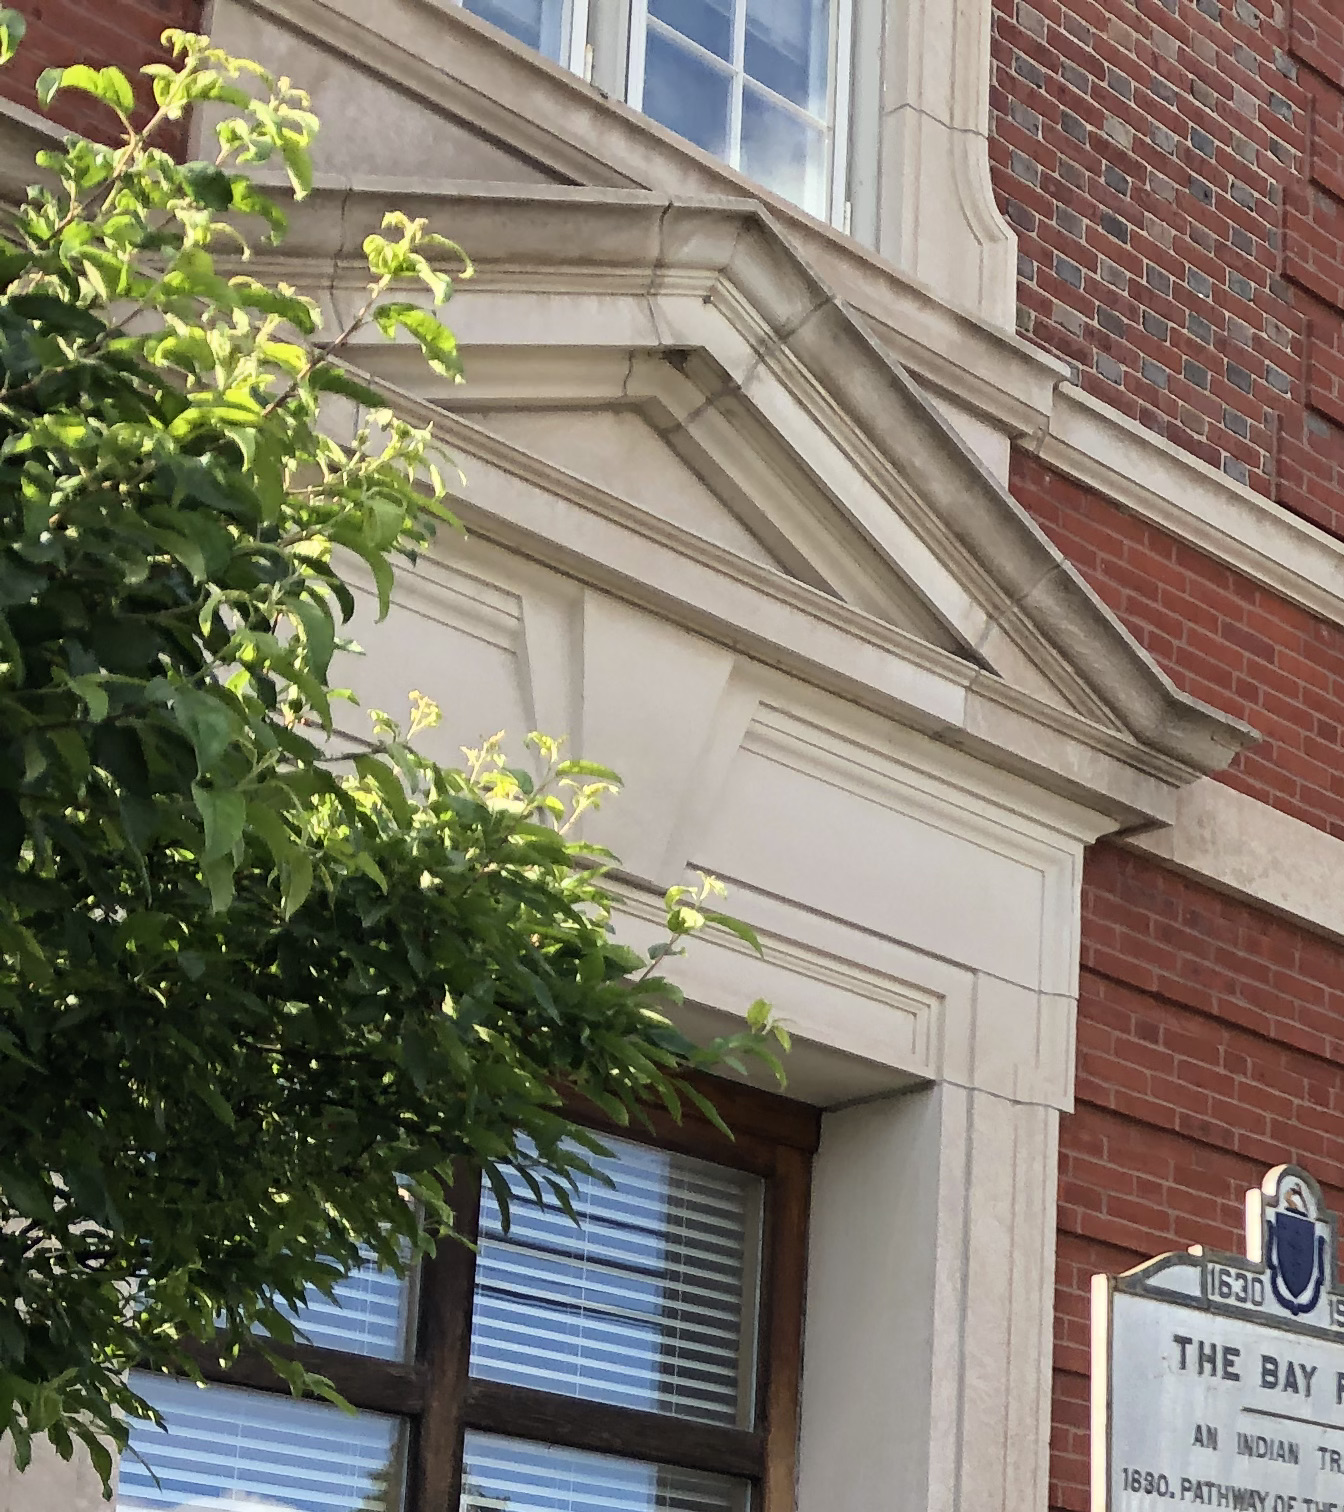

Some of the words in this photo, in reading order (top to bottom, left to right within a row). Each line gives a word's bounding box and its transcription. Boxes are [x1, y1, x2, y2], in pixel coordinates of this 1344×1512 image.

[1208, 1265, 1265, 1306] 1630
[1173, 1334, 1240, 1382] THE
[1260, 1354, 1318, 1397] BAY
[1192, 1424, 1218, 1450] AN
[1236, 1431, 1299, 1465] INDIAN
